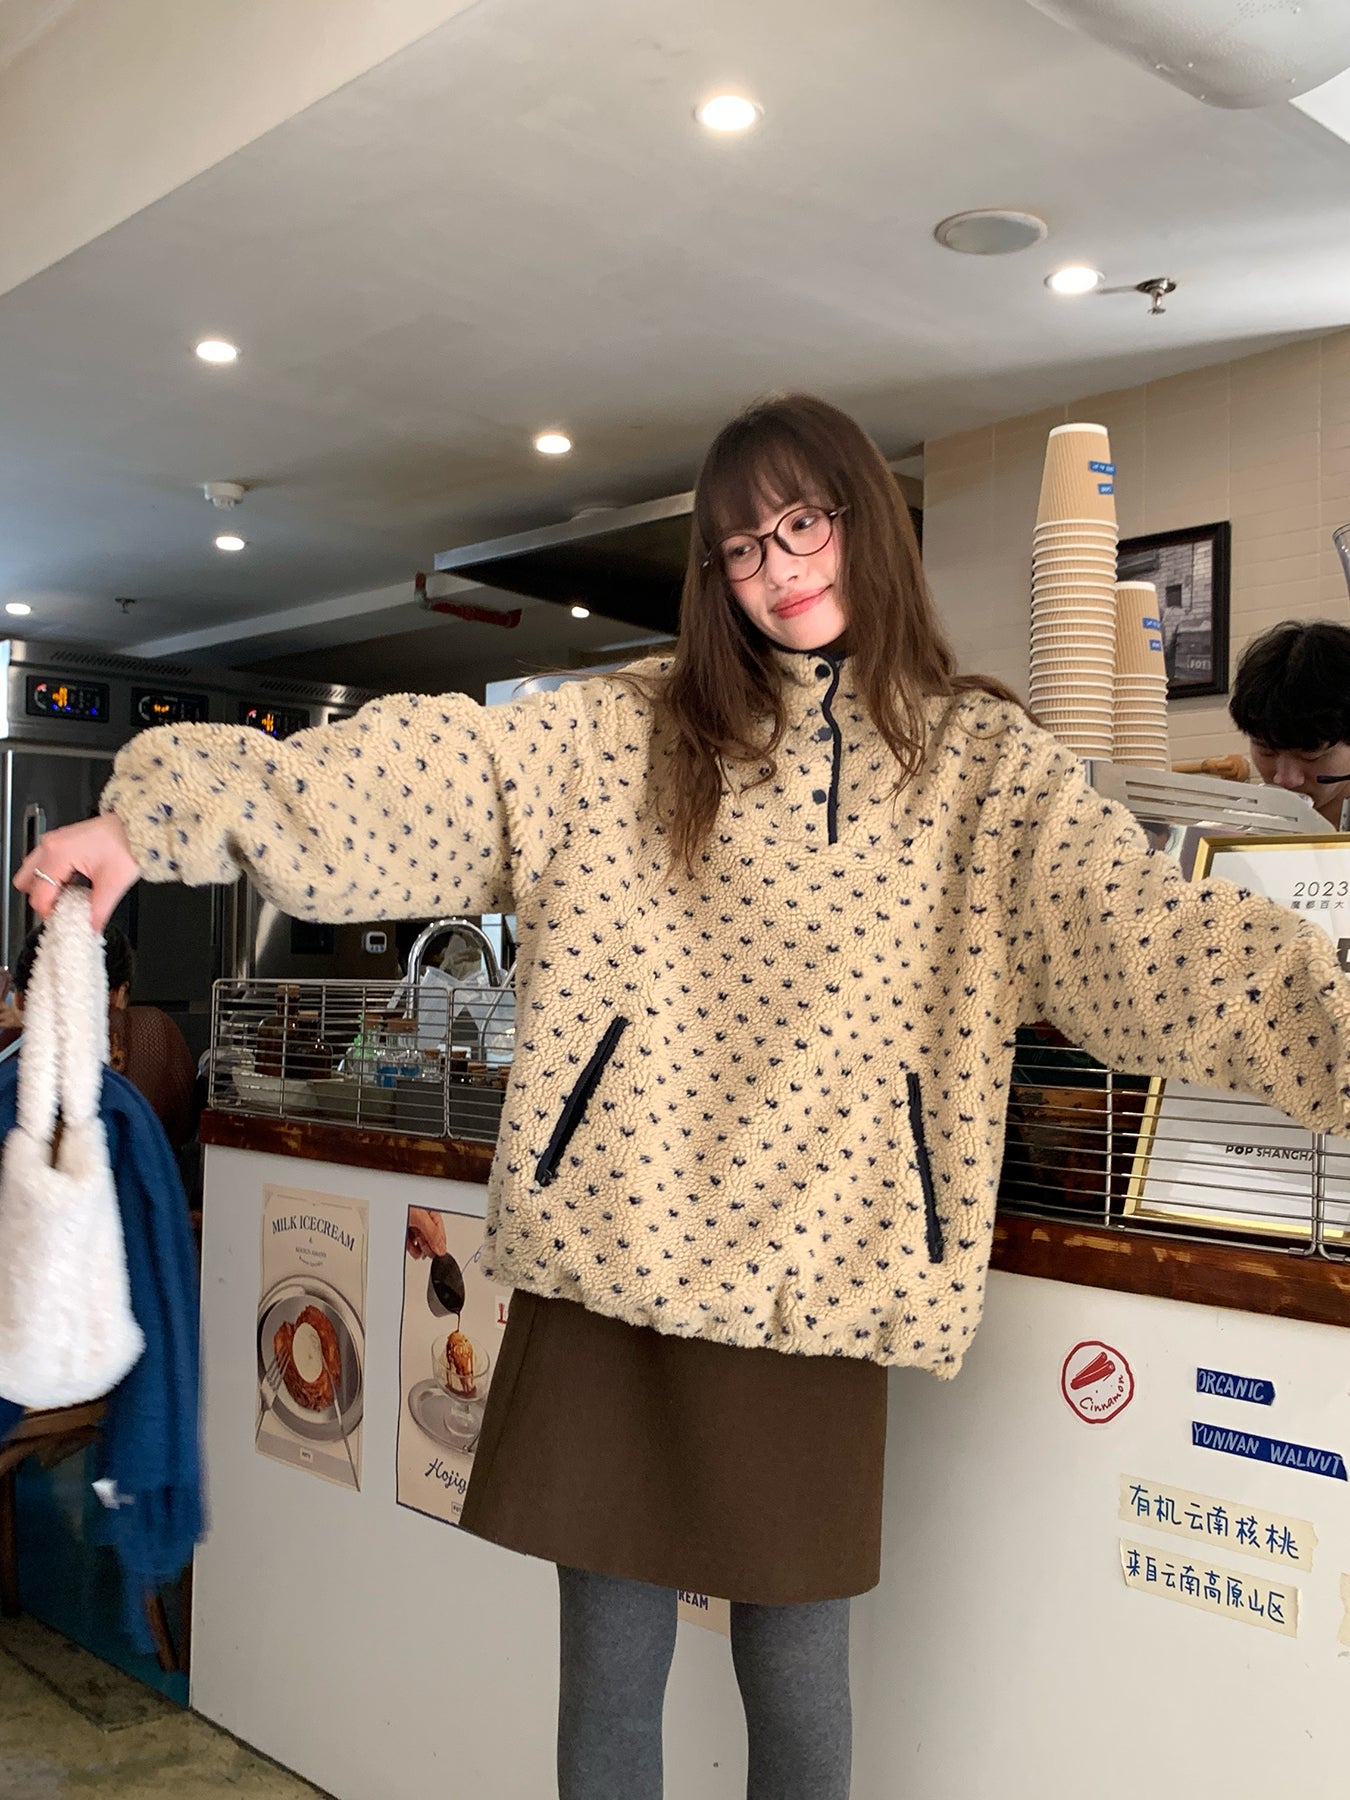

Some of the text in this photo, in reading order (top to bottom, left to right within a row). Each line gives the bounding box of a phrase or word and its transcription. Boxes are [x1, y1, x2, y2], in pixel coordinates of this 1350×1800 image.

[1293, 881, 1349, 897] 2023
[1225, 1144, 1315, 1162] POP SHANGHA
[272, 1215, 297, 1234] MILK
[300, 1215, 355, 1252] ICECREAM
[1080, 1374, 1125, 1412] Cinnamon
[1199, 1370, 1265, 1401] ORGANIC
[1193, 1422, 1343, 1476] YUNNAN WALNUT
[1129, 1484, 1300, 1560] 有机云南核桃
[678, 1589, 709, 1611] REAM
[1126, 1549, 1285, 1625] 来自云南高原山区
